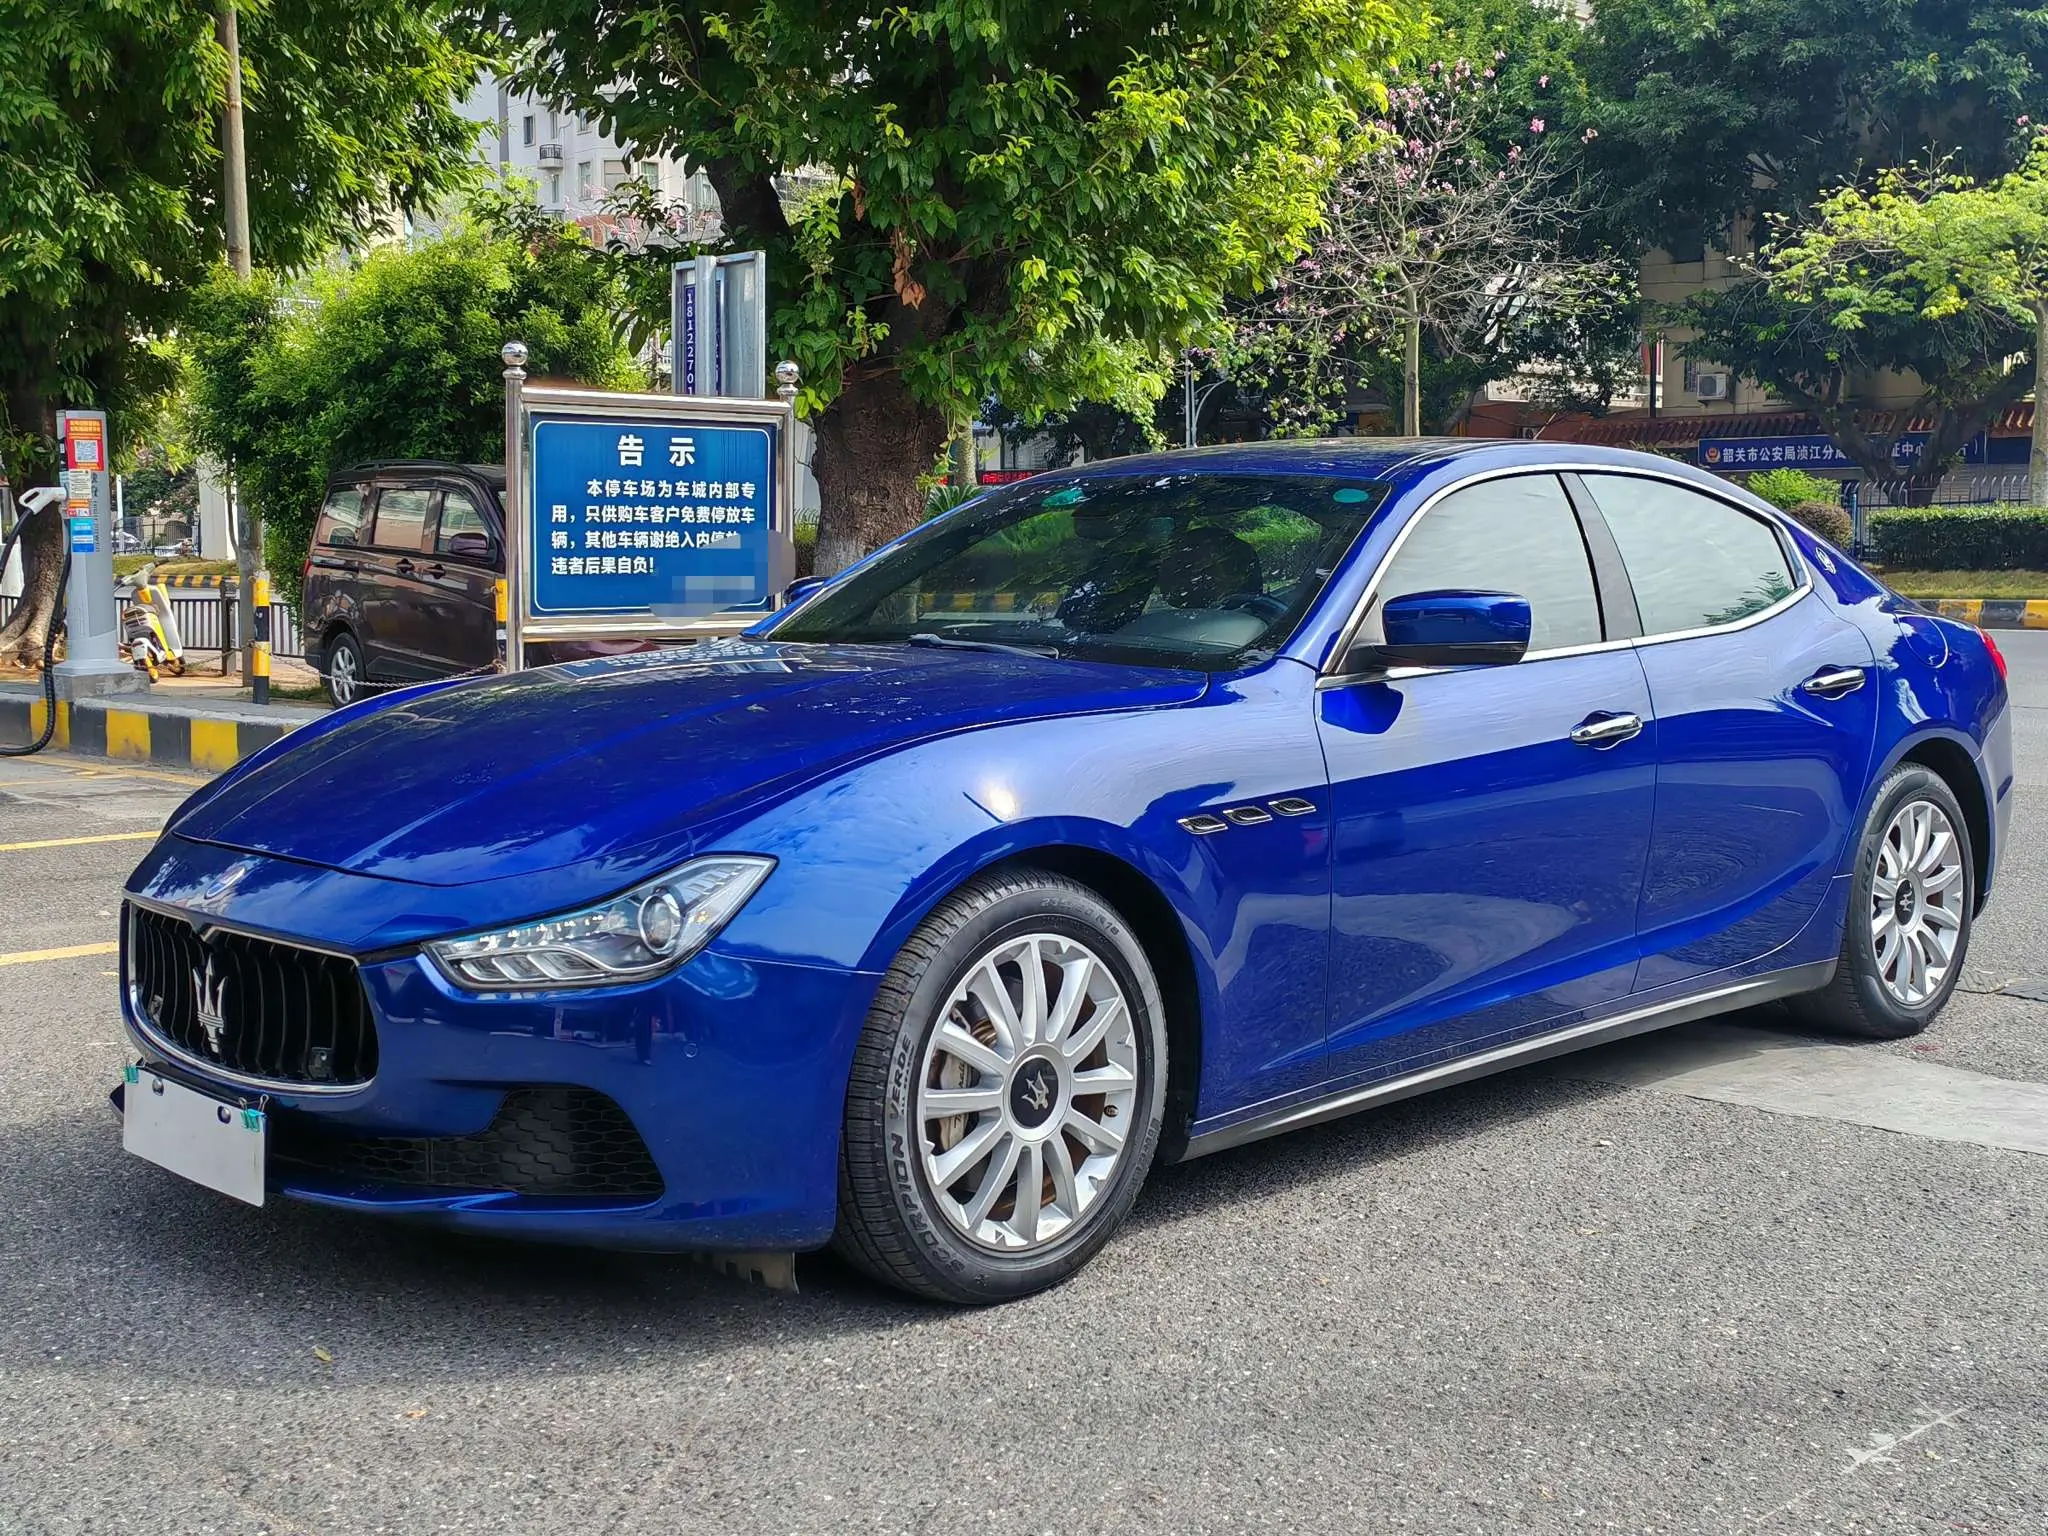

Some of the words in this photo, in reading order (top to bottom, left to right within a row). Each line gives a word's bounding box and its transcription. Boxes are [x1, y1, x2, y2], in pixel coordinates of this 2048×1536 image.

[617, 434, 696, 467] 告示
[587, 479, 756, 500] 本停车场为车城内部专
[552, 504, 756, 524] 用,只供购车客户免费停放车
[552, 556, 654, 575] 违者后果自负!
[890, 1035, 912, 1121] VERDE
[891, 1132, 966, 1274] SCORPION
